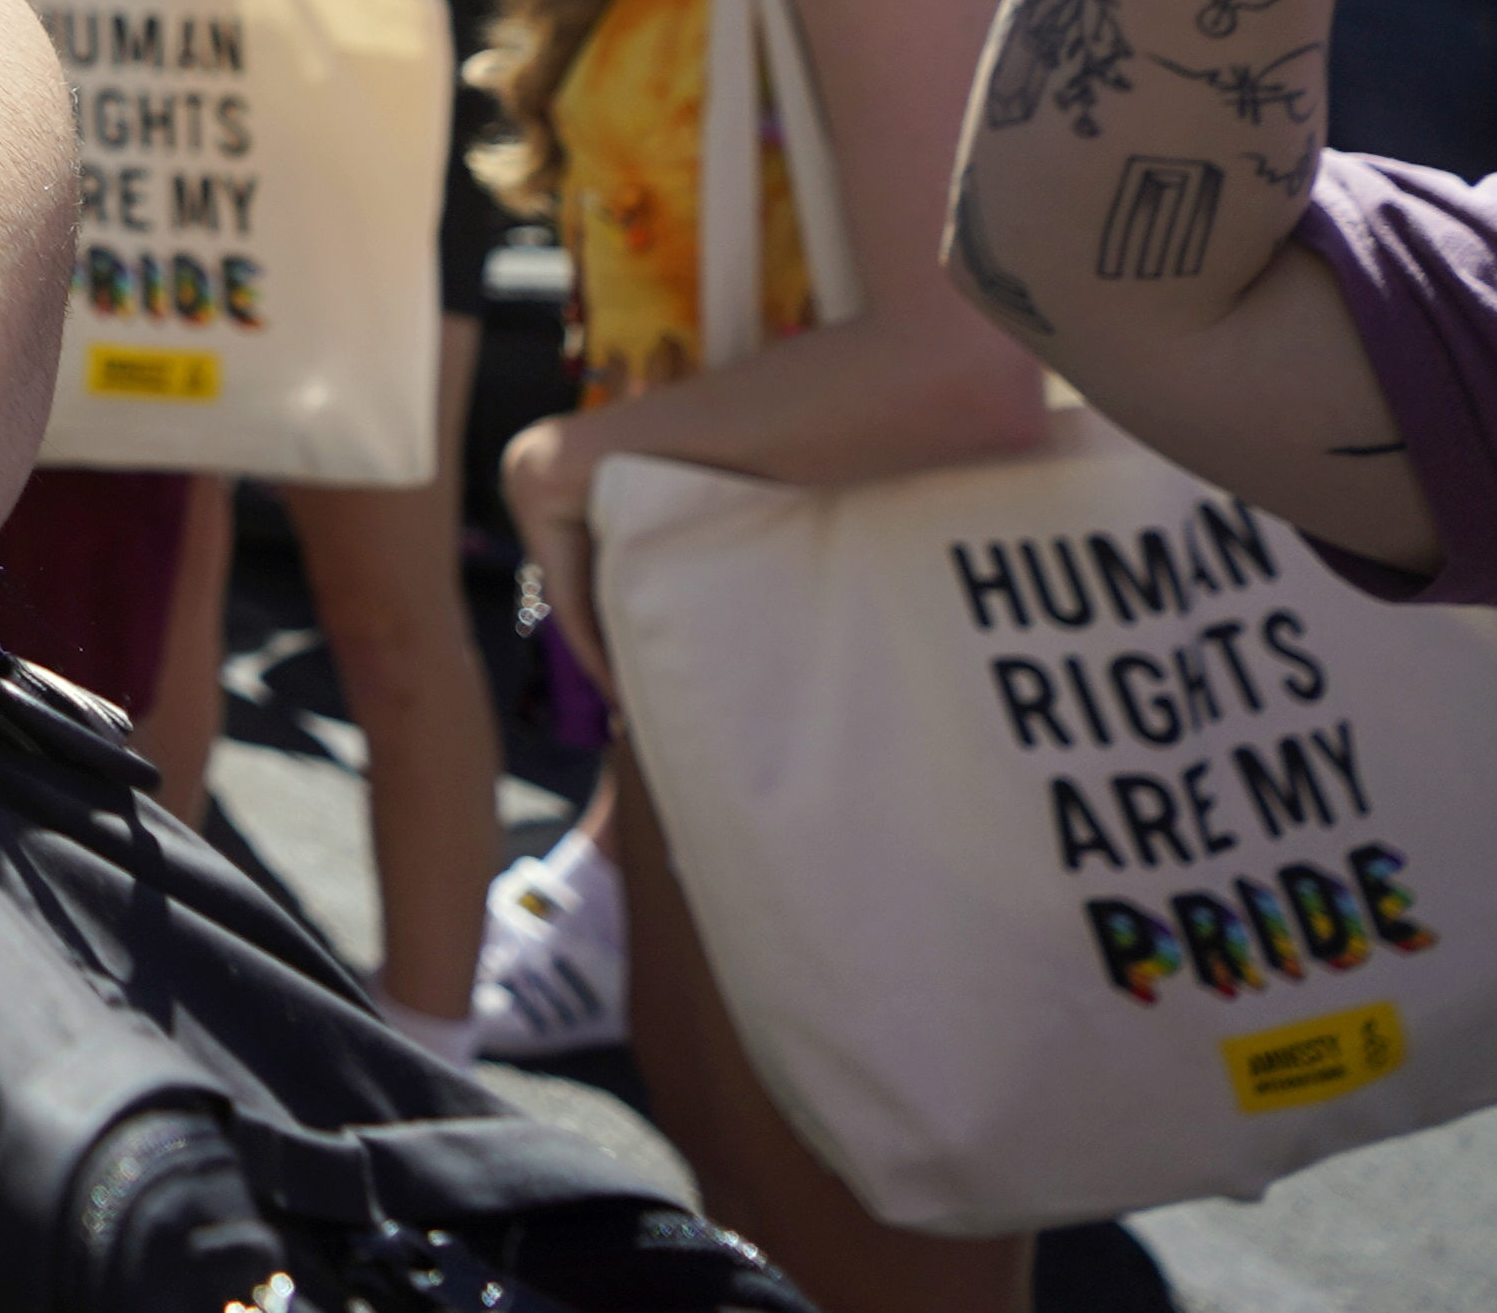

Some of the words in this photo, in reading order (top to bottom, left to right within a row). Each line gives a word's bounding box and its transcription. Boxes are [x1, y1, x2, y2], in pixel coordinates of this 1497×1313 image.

[171, 173, 257, 240] MY
[72, 243, 268, 335] RIDE
[946, 496, 1281, 633] HUMAN
[989, 606, 1329, 753] RIGHTS
[1048, 762, 1237, 875] ARE
[1232, 718, 1376, 850] MY
[1083, 839, 1441, 1007] PRIDE
